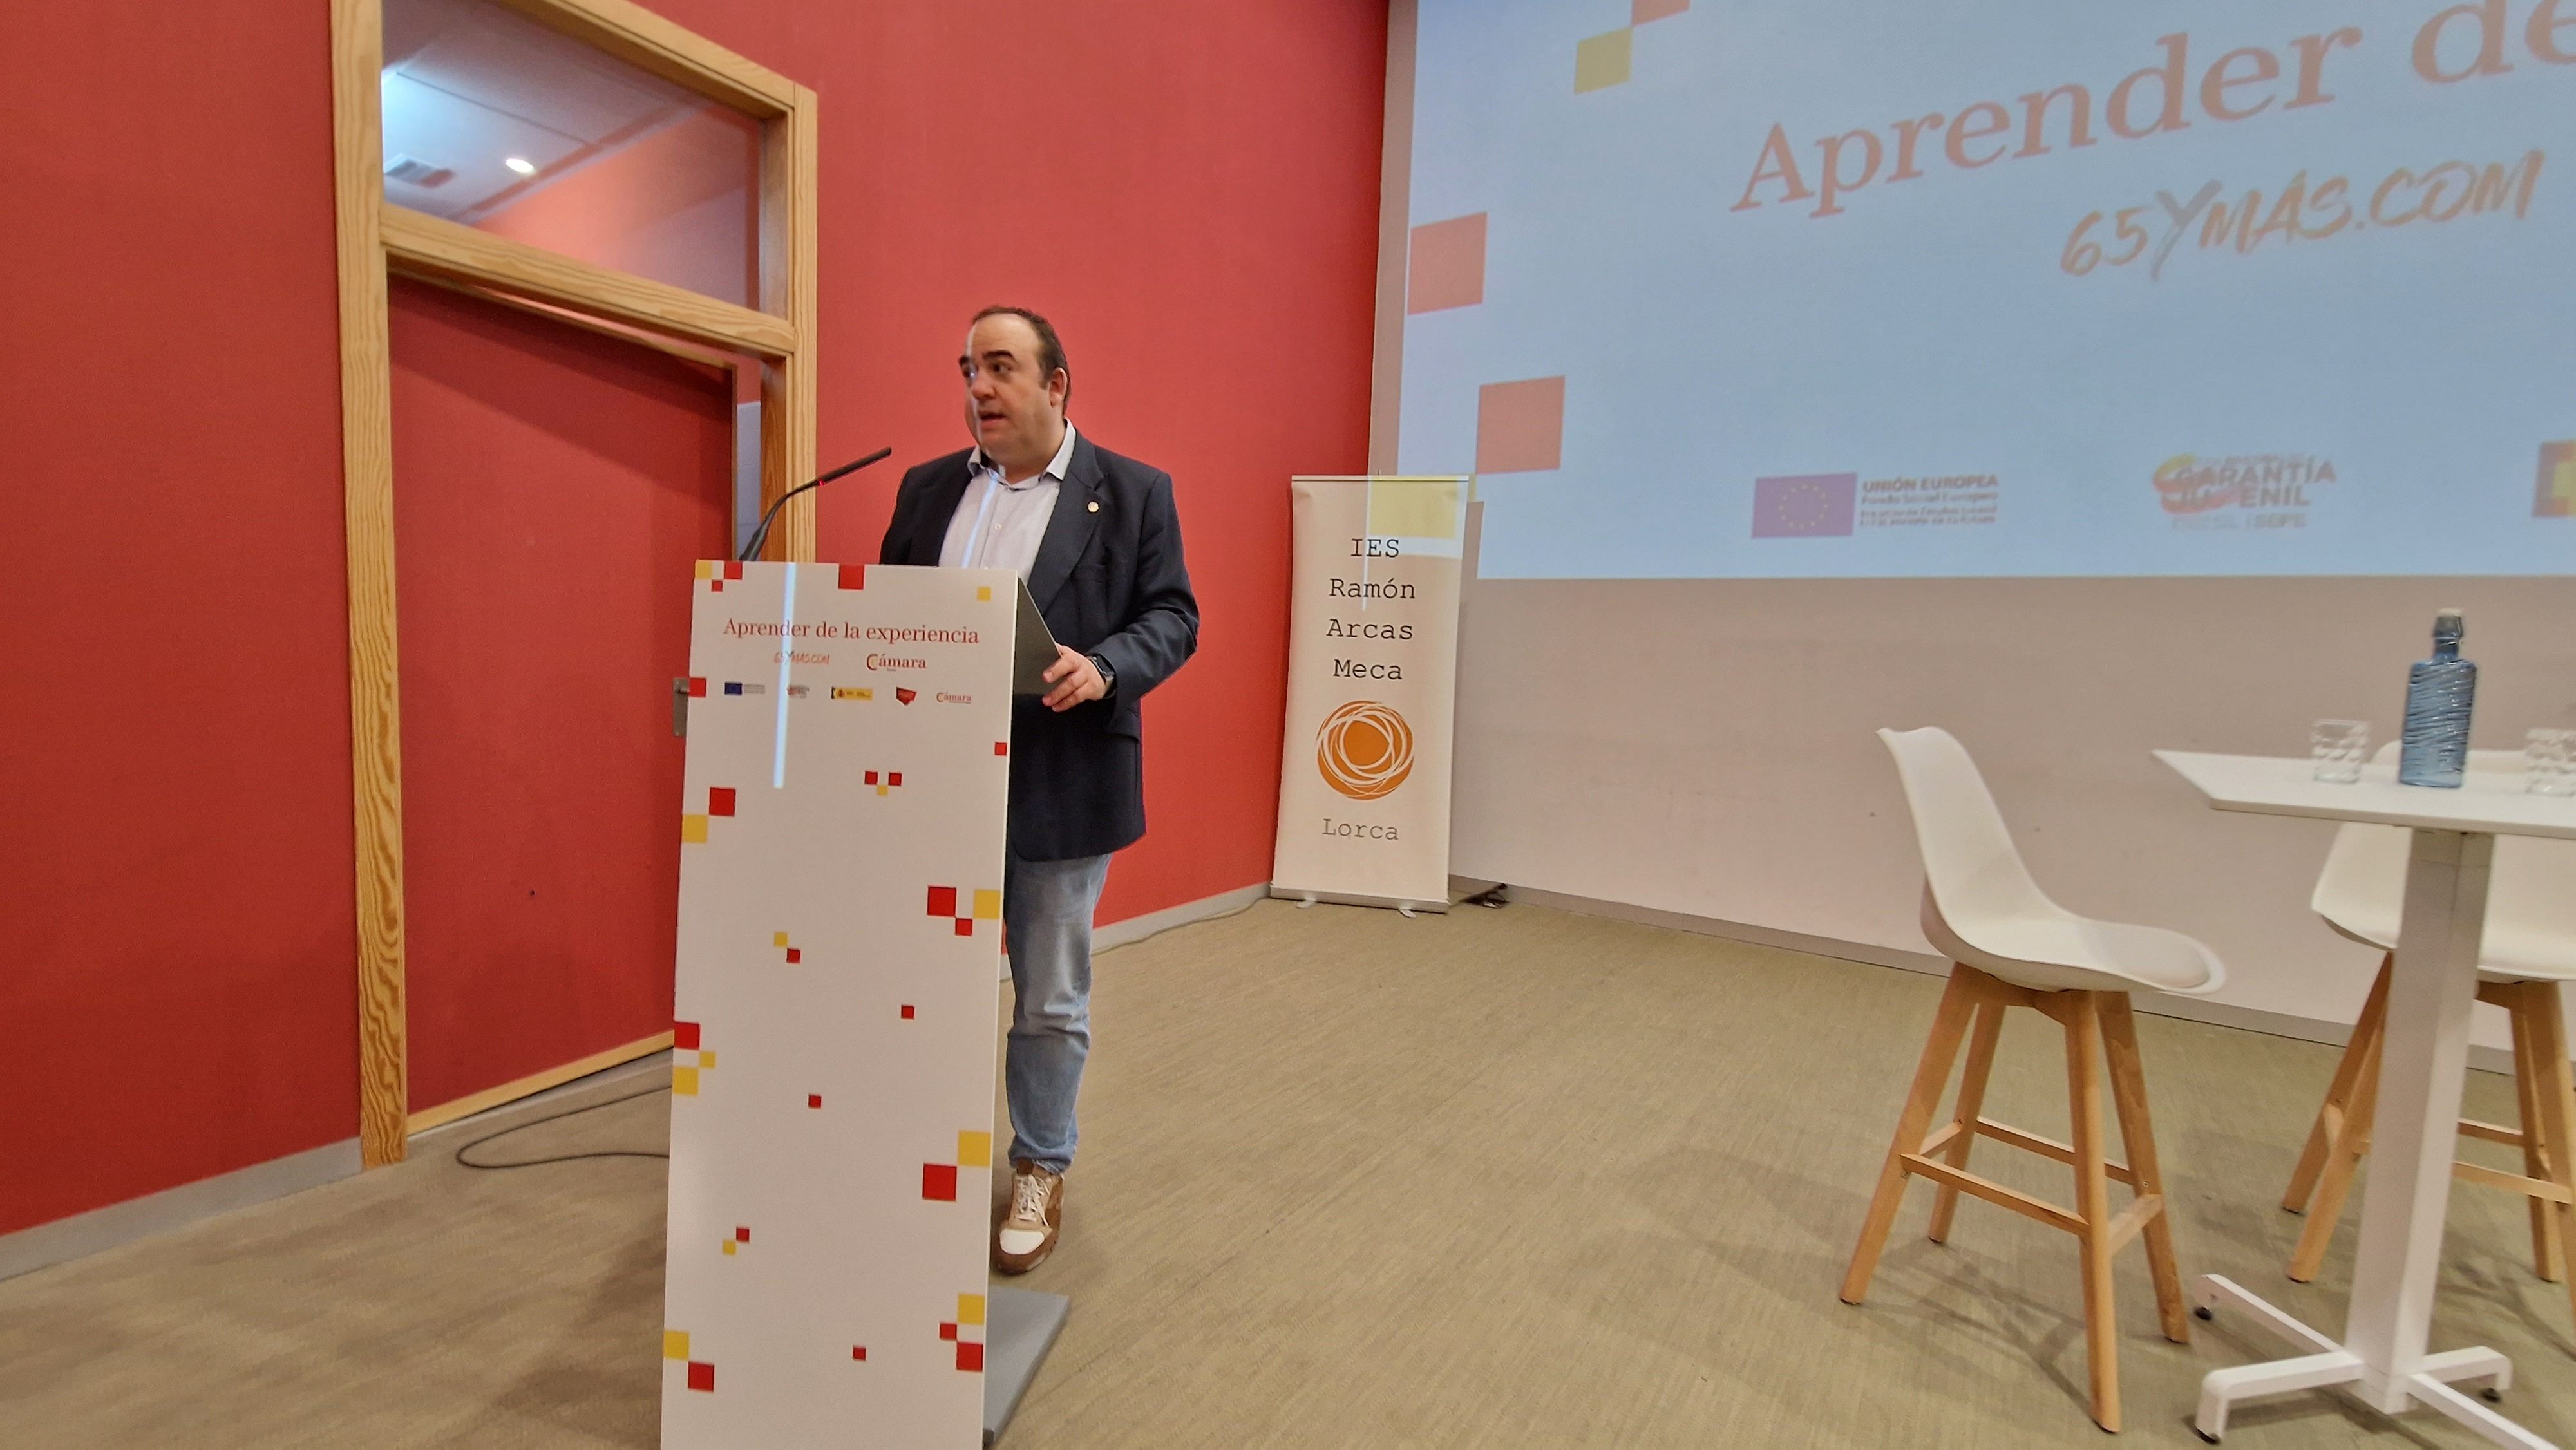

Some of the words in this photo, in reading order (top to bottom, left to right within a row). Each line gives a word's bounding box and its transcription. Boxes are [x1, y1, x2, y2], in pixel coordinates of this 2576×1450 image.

[1730, 26, 2363, 219] Aprender
[1863, 475, 1918, 493] UNIÓN
[1920, 473, 1999, 491] EUROPEA
[1350, 538, 1399, 558] IES
[1329, 578, 1415, 599] Ramón
[723, 618, 810, 639] Aprender
[816, 621, 838, 639] de
[844, 621, 860, 639] la
[866, 625, 979, 645] experiencia
[1326, 618, 1412, 640] Arcas
[867, 653, 927, 671] Cámara
[1332, 659, 1403, 680] Meca
[936, 692, 972, 702] Cámara
[1322, 818, 1399, 840] Lorca
